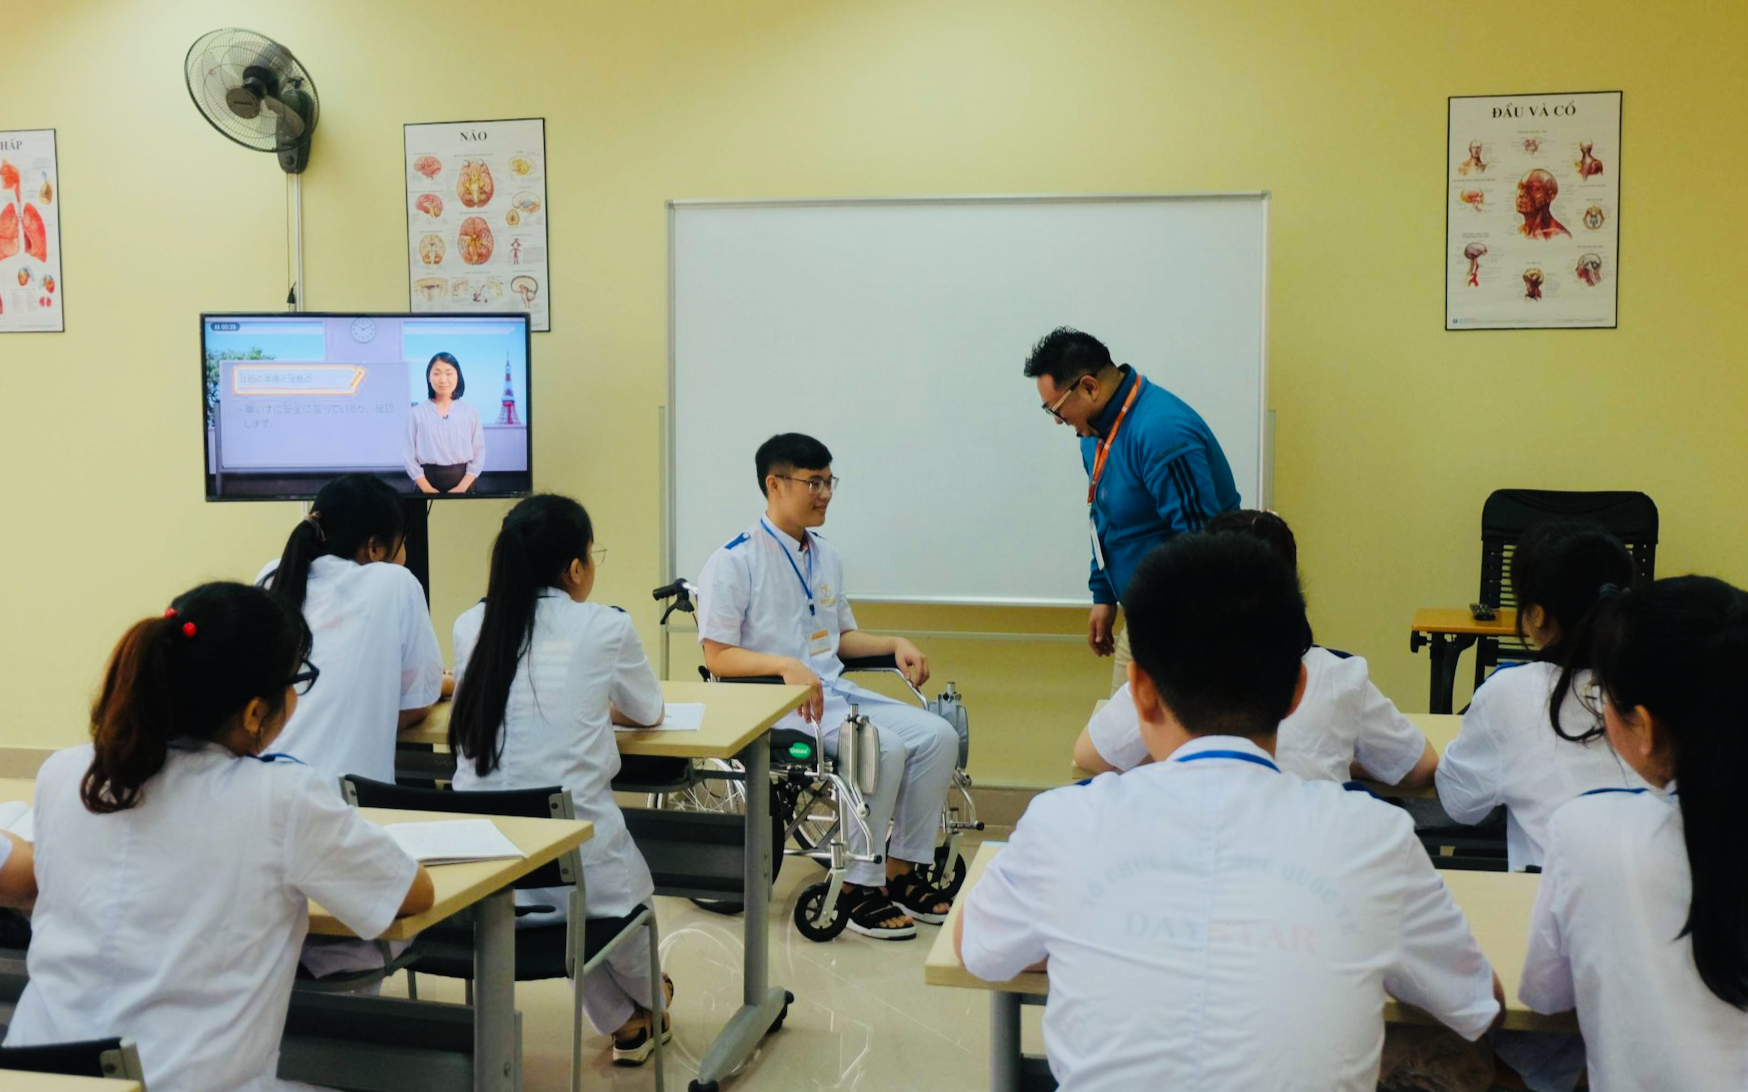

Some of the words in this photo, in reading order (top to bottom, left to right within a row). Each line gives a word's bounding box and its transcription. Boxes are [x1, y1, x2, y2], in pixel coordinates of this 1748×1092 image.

[1492, 102, 1524, 119] ĐẦU
[1529, 103, 1549, 117] VÀ
[460, 129, 488, 142] NÃO
